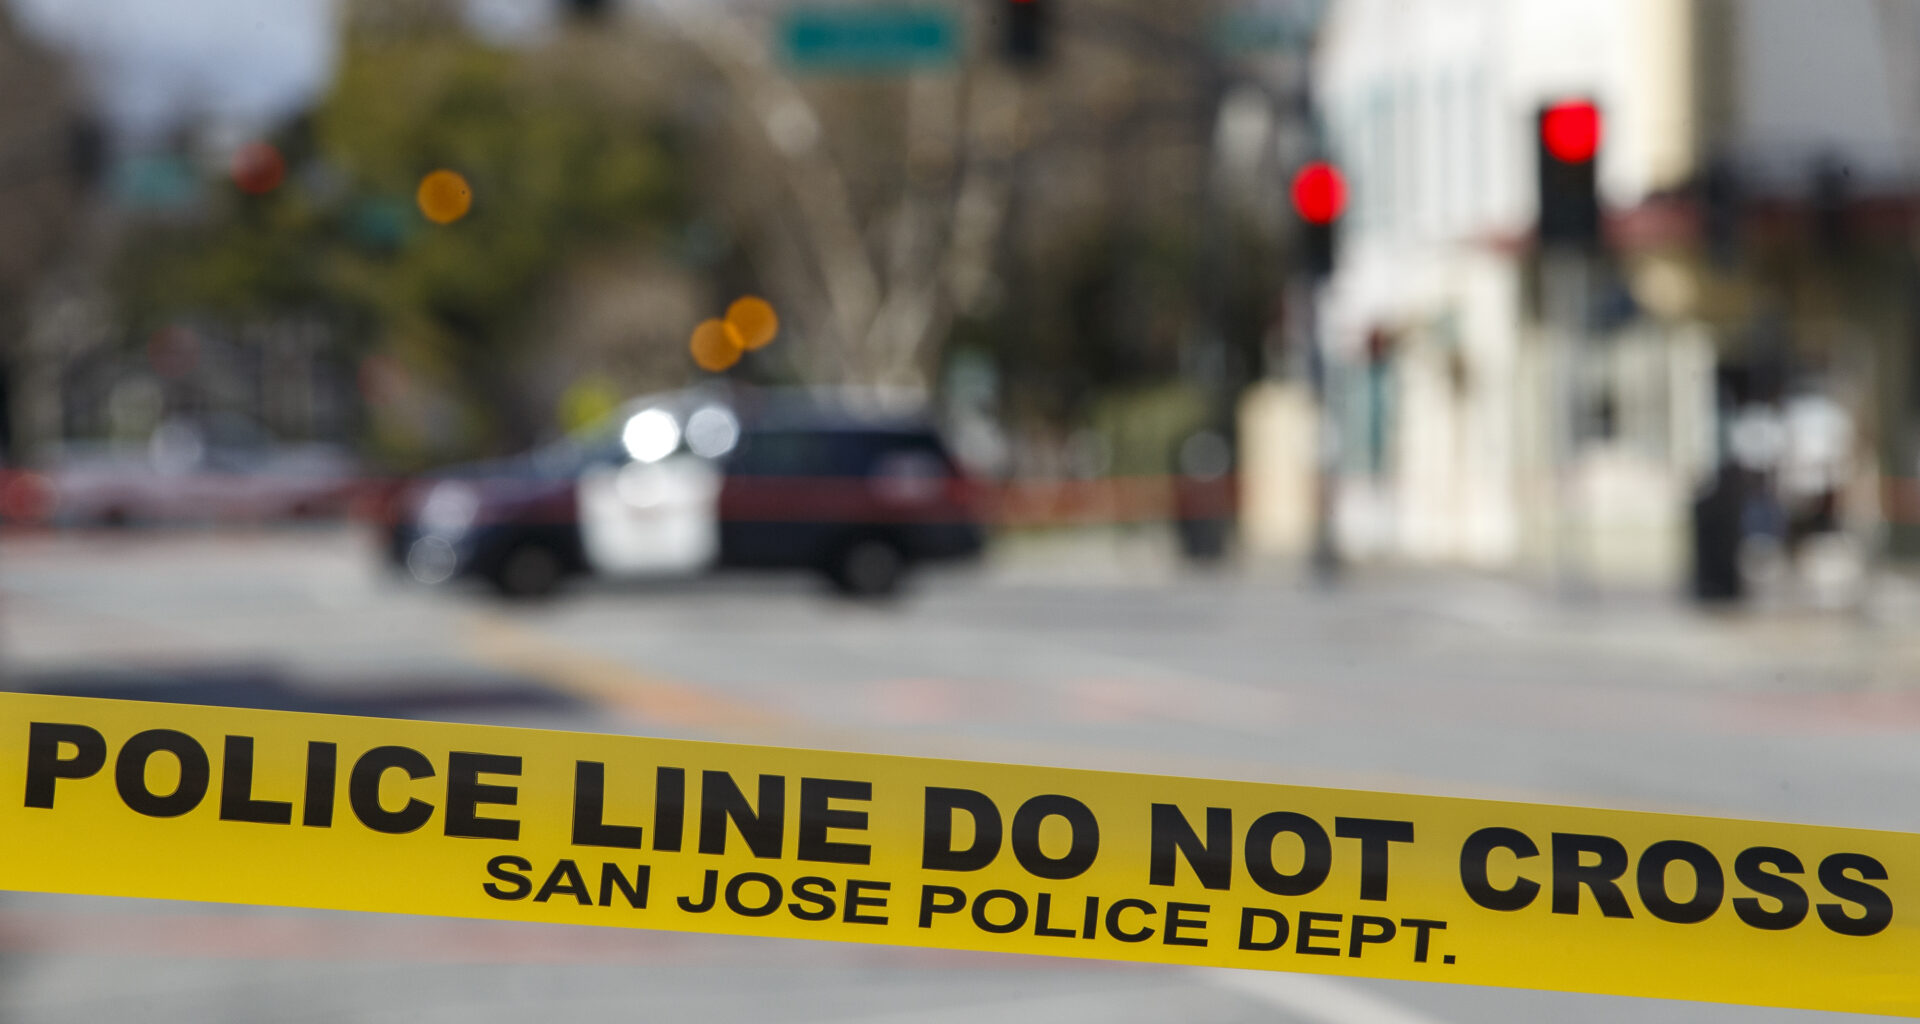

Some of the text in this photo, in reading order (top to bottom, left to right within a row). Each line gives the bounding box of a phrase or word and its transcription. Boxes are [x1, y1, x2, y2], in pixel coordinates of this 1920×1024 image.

[23, 721, 1894, 937] POLICE LINE DO NOT CROSS
[482, 855, 1457, 966] SAN JOSE POLICE DEPT.
